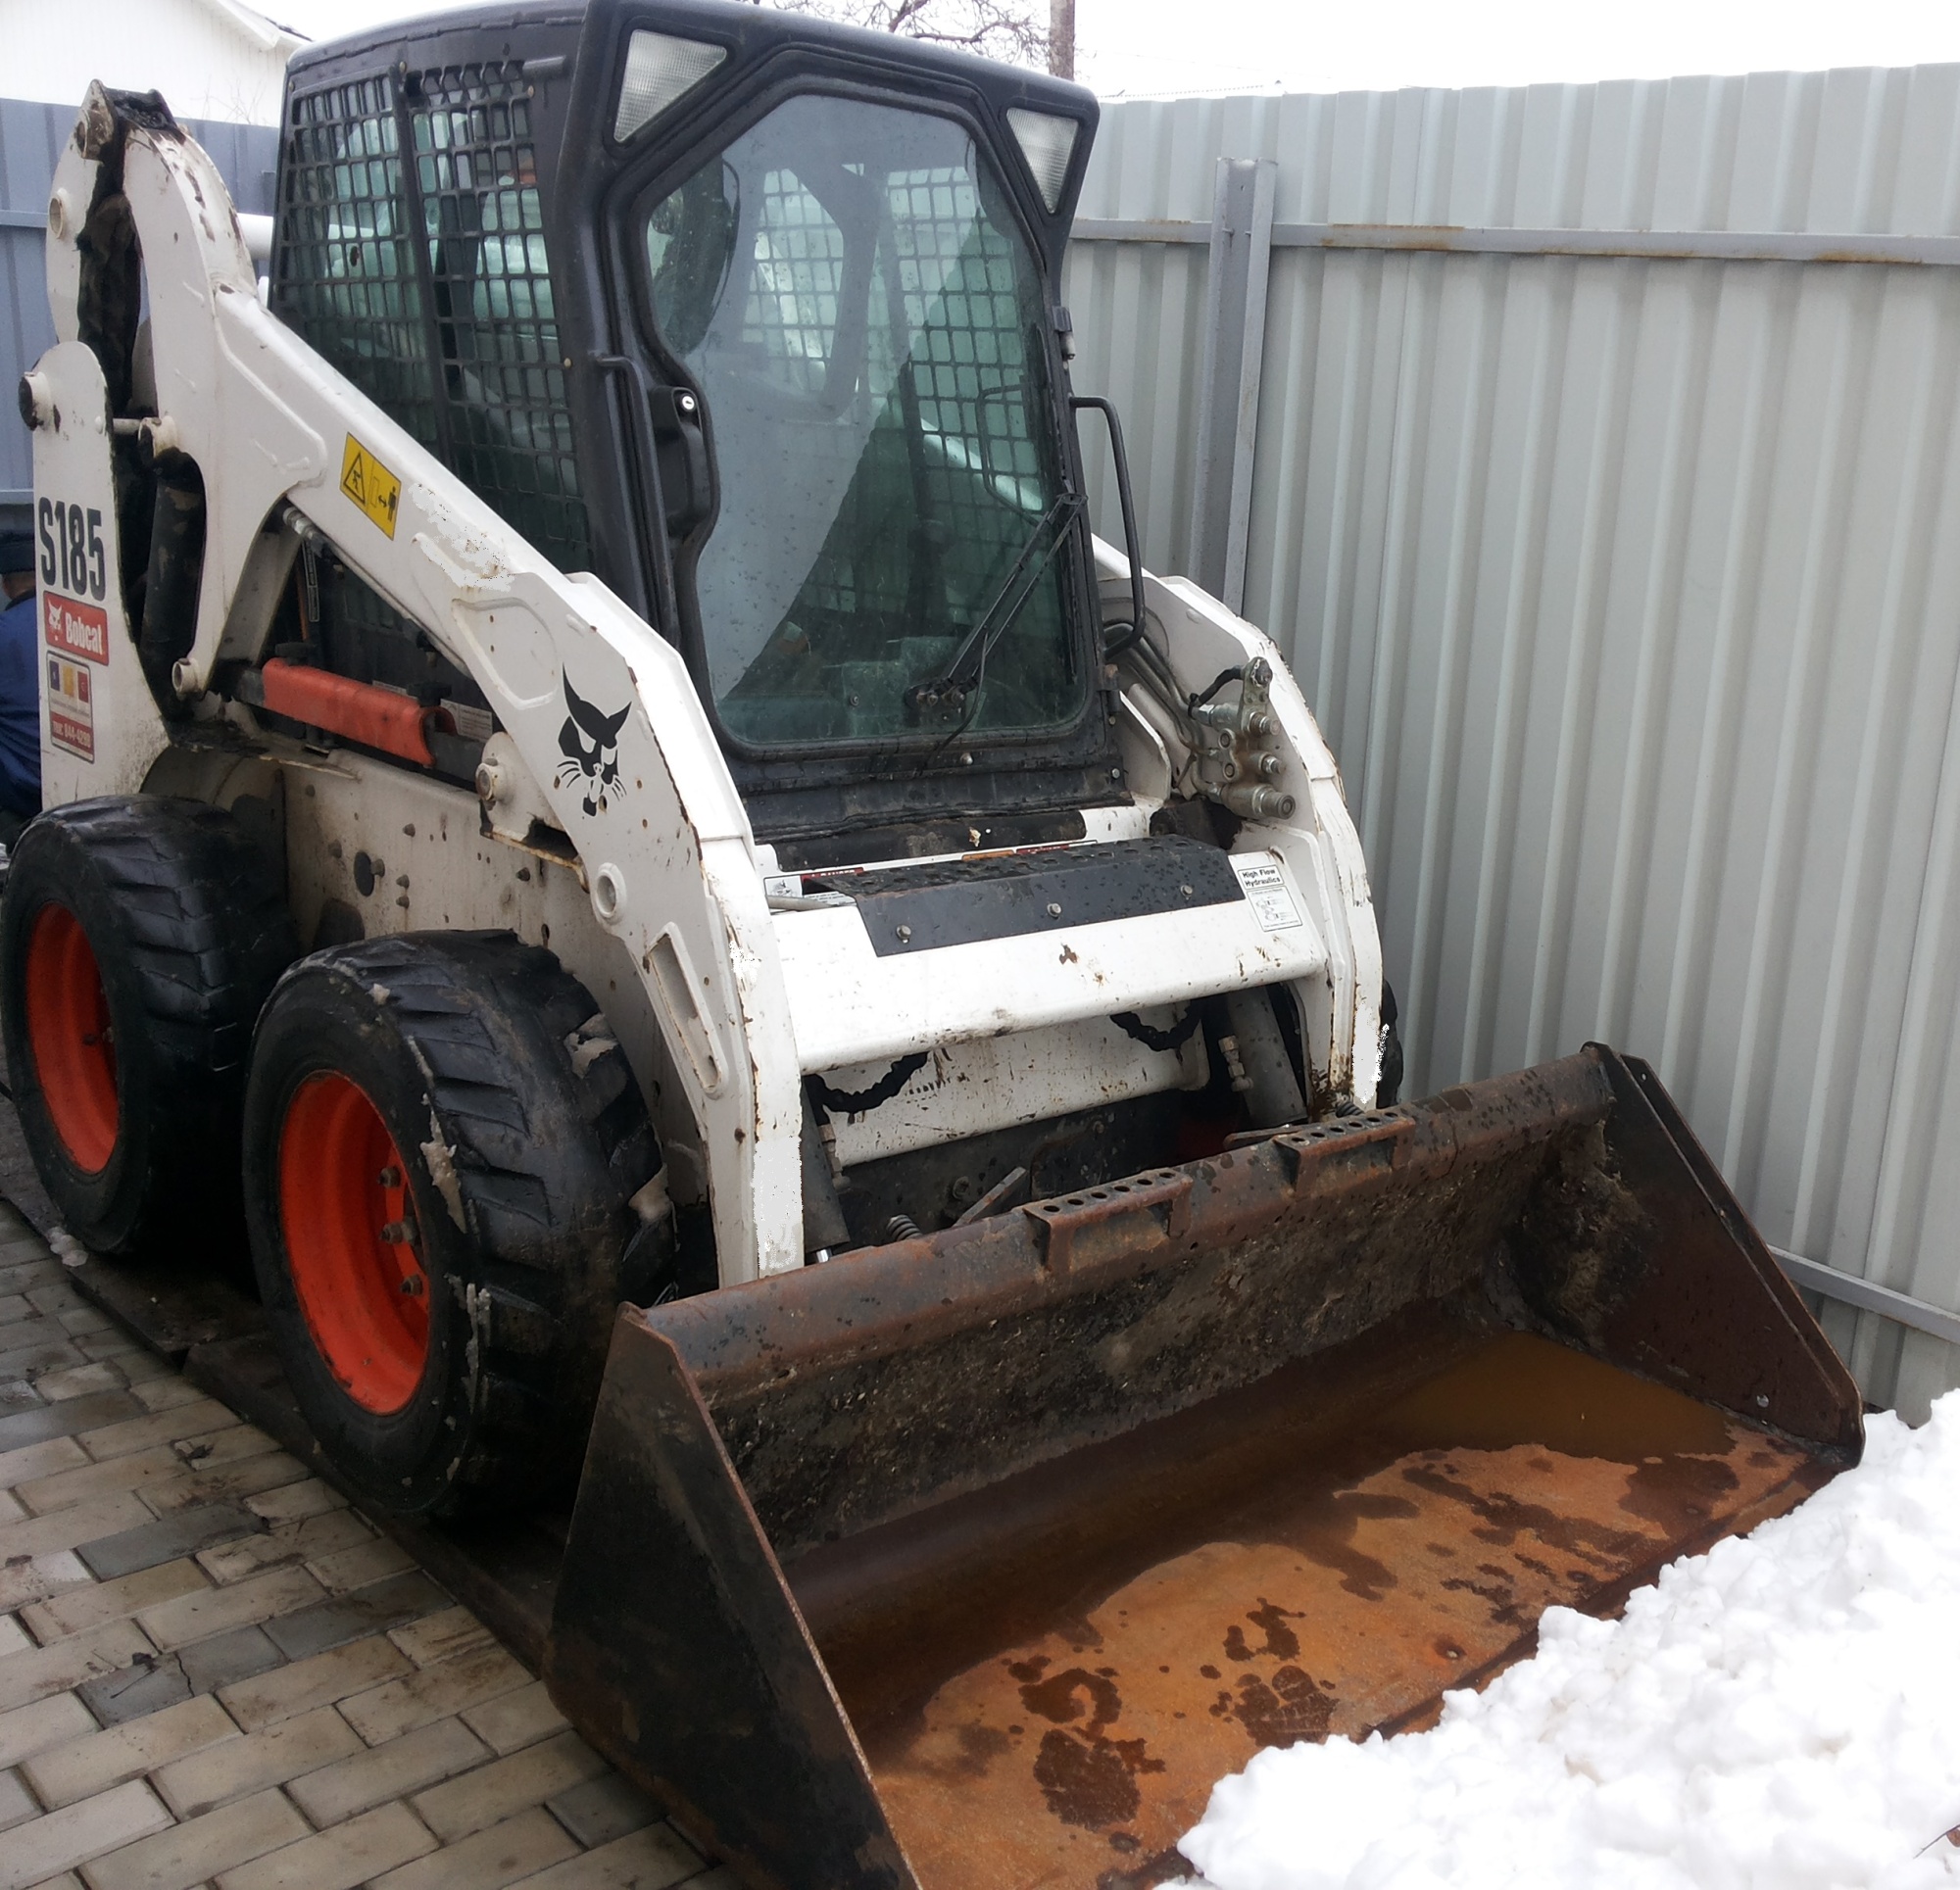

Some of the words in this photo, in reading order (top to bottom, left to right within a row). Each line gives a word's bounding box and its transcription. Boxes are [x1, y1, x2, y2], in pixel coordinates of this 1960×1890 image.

[38, 496, 107, 602] S185
[65, 611, 103, 655] Bobcat
[1242, 870, 1258, 879] High
[1245, 877, 1281, 888] Hydraulics
